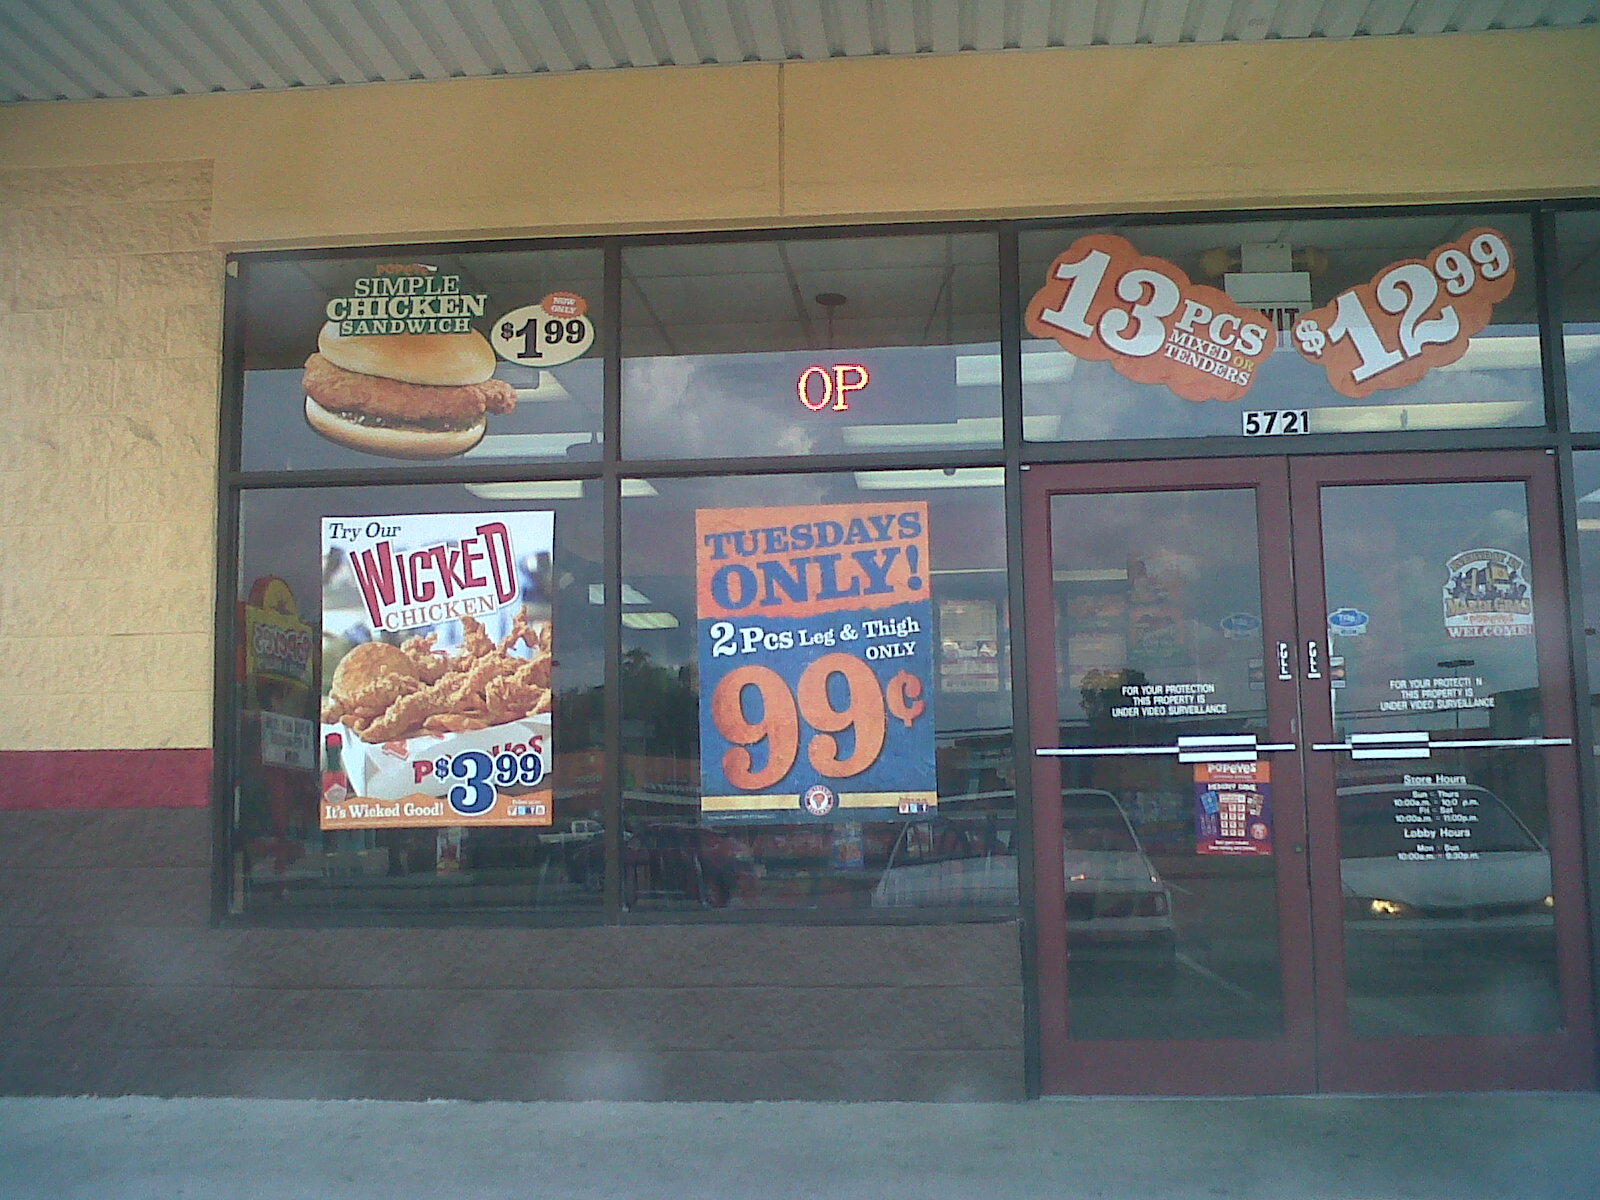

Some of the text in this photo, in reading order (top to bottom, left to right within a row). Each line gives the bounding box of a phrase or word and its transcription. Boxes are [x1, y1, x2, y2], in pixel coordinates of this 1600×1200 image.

[354, 275, 460, 298] SIMPLE
[326, 294, 487, 321] CHICKEN
[1041, 249, 1268, 357] 13 PCS
[340, 318, 472, 335] SANDWICH
[1169, 329, 1254, 372] MIXED OR
[1164, 343, 1251, 387] TENDERS
[797, 364, 869, 411] OP
[1246, 411, 1308, 434] 5721
[329, 522, 401, 542] Try Our
[704, 512, 923, 561] TUESDAYS
[350, 522, 516, 629] WICKED
[710, 545, 923, 611] ONLY!
[386, 595, 495, 630] CHICKEN
[799, 629, 836, 647] Leg
[839, 625, 859, 641] &
[862, 616, 921, 639] Thigh
[865, 642, 916, 660] ONLY
[1122, 683, 1215, 695] FOR YOUR PROTECTION
[1390, 680, 1407, 689] FOR
[1409, 679, 1431, 688] YOUR
[1401, 687, 1474, 699] THIS PROPERTY IS
[1112, 704, 1227, 717] UNDER VIDEO SURVEILLANCE
[1133, 694, 1206, 706] THIS PROPERTY IS
[1380, 697, 1495, 711] UNDER VIDEO SURVEILLANCE
[1403, 774, 1466, 785] Store Hours
[325, 802, 444, 819] It's Wicked Good!
[1403, 827, 1471, 839] Lobby Hours
